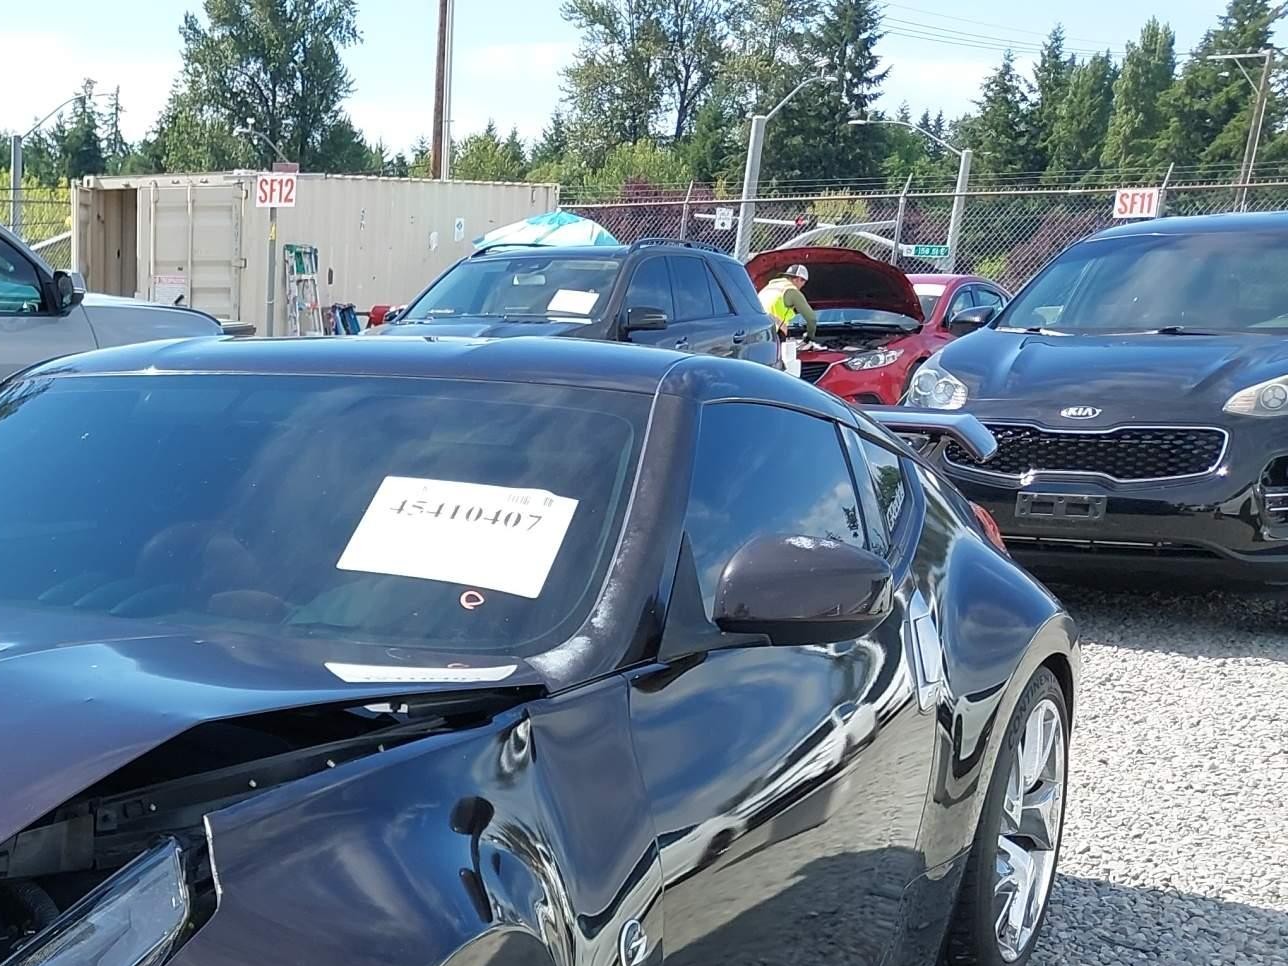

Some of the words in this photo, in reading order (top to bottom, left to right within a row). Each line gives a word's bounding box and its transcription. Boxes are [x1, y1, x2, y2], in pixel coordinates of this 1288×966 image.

[258, 177, 294, 203] SF12
[1117, 192, 1154, 215] SF11
[1065, 406, 1094, 417] KIA
[1007, 673, 1056, 751] CONTINEN
